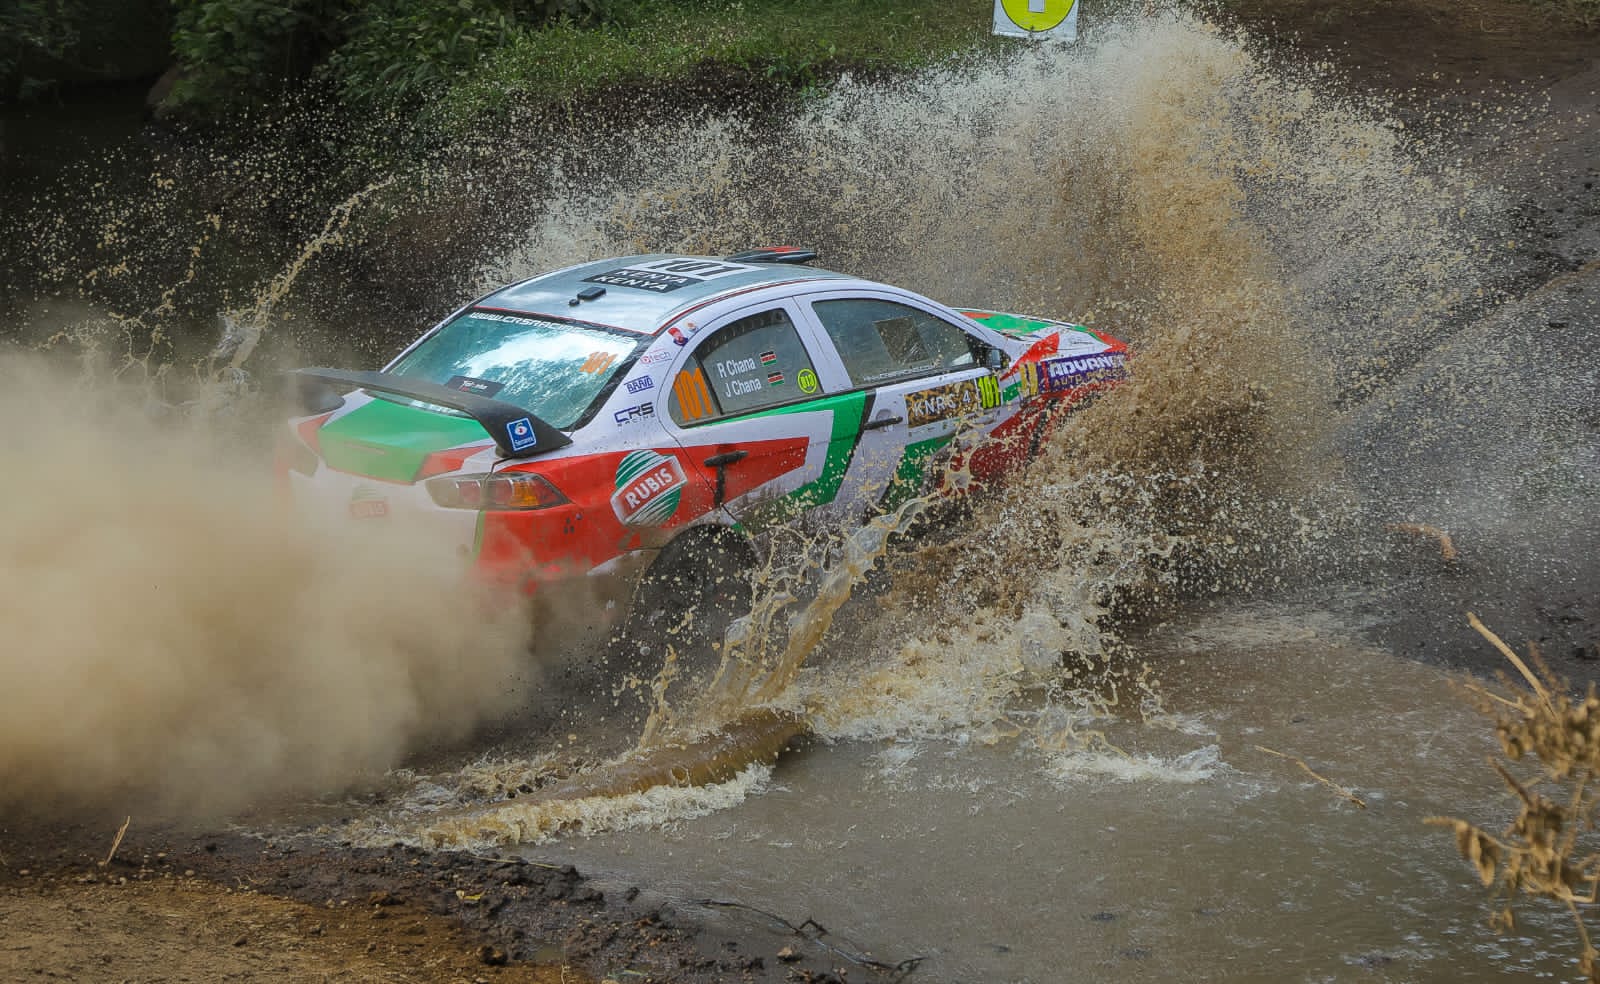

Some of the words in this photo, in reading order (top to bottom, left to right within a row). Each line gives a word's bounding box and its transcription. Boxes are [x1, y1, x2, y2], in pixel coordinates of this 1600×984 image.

[615, 270, 689, 284] KENYA
[648, 260, 747, 277] 101
[594, 276, 668, 290] KENYA
[716, 362, 728, 379] R
[726, 357, 757, 376] Chana
[673, 367, 713, 423] 101
[725, 382, 732, 398] J
[731, 378, 762, 396] Chana
[962, 390, 971, 404] 4
[978, 375, 1000, 409] 101
[614, 402, 655, 423] CRS
